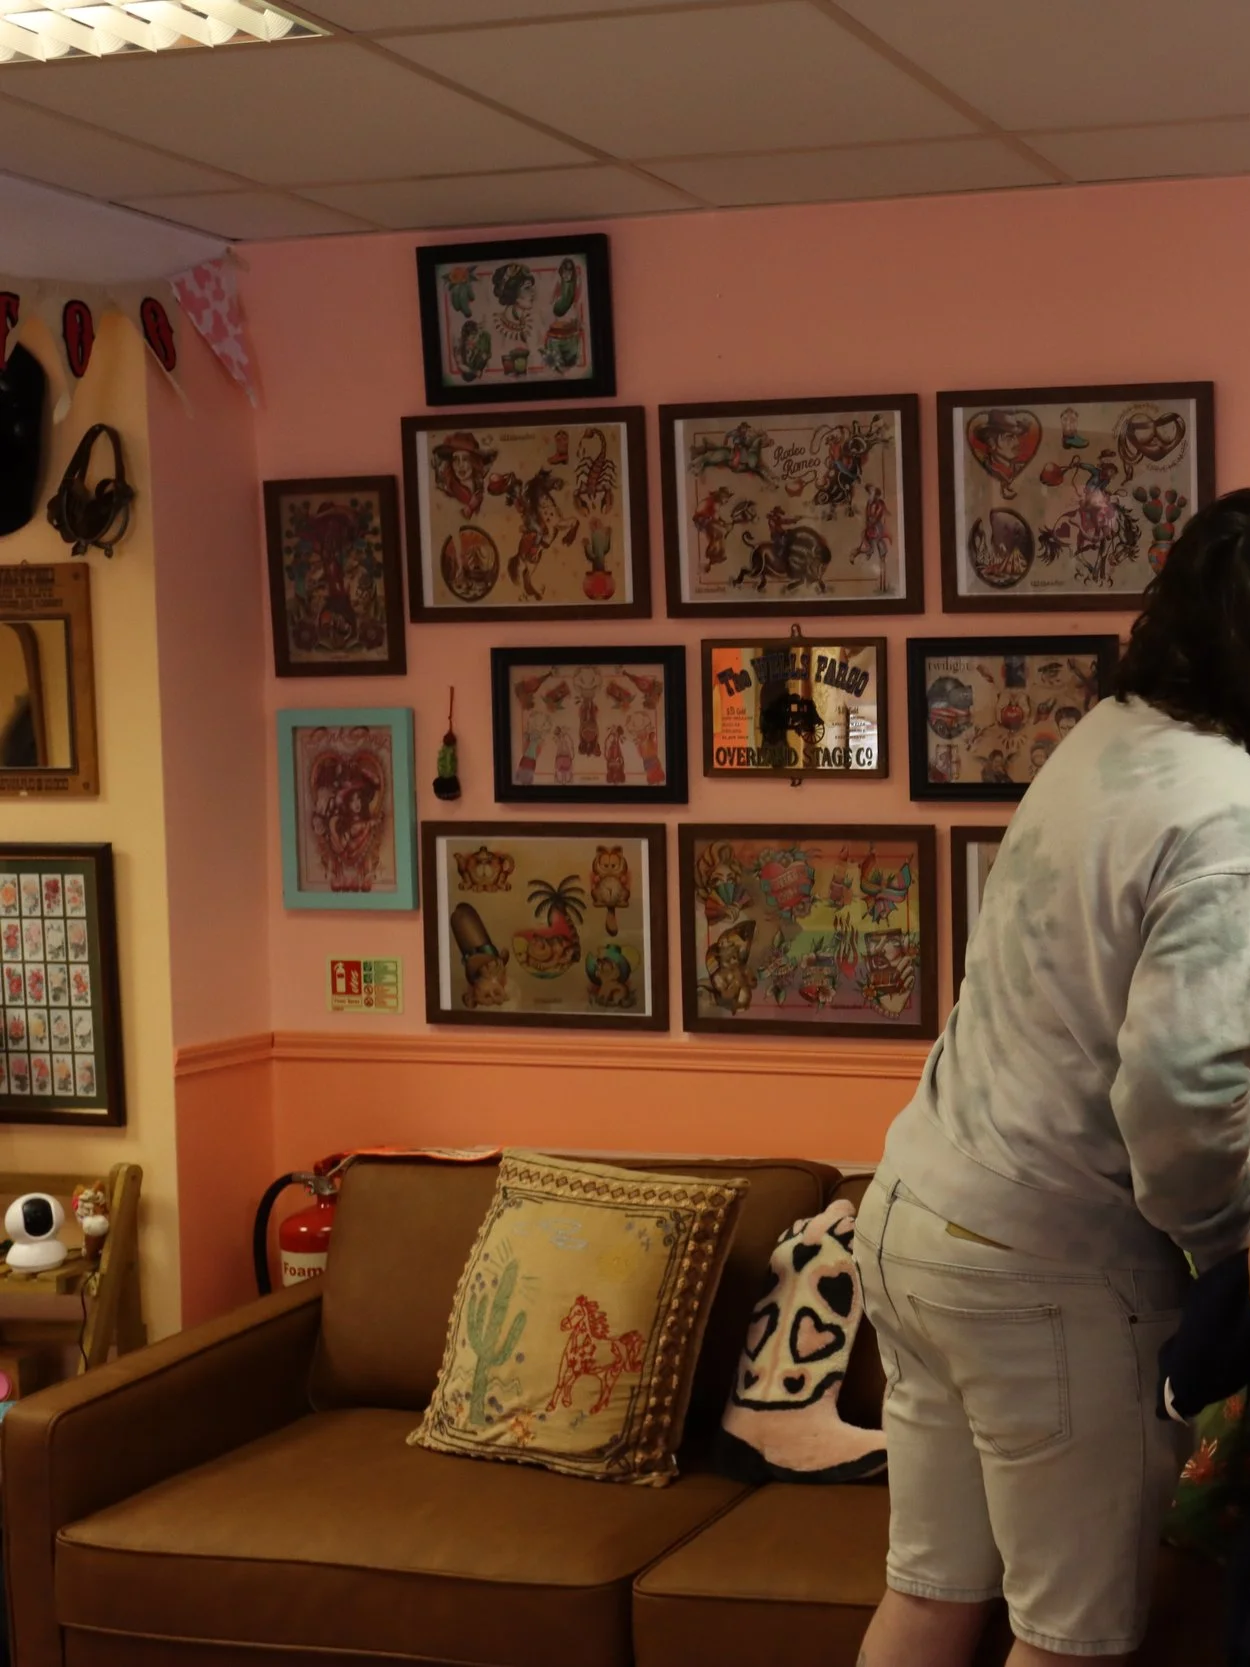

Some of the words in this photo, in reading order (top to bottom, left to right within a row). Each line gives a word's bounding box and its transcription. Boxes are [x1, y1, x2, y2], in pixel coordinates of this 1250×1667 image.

[773, 443, 806, 466] Rodeo
[782, 457, 822, 480] Romeo
[816, 655, 870, 698] FARGO
[283, 1261, 325, 1277] Foam
